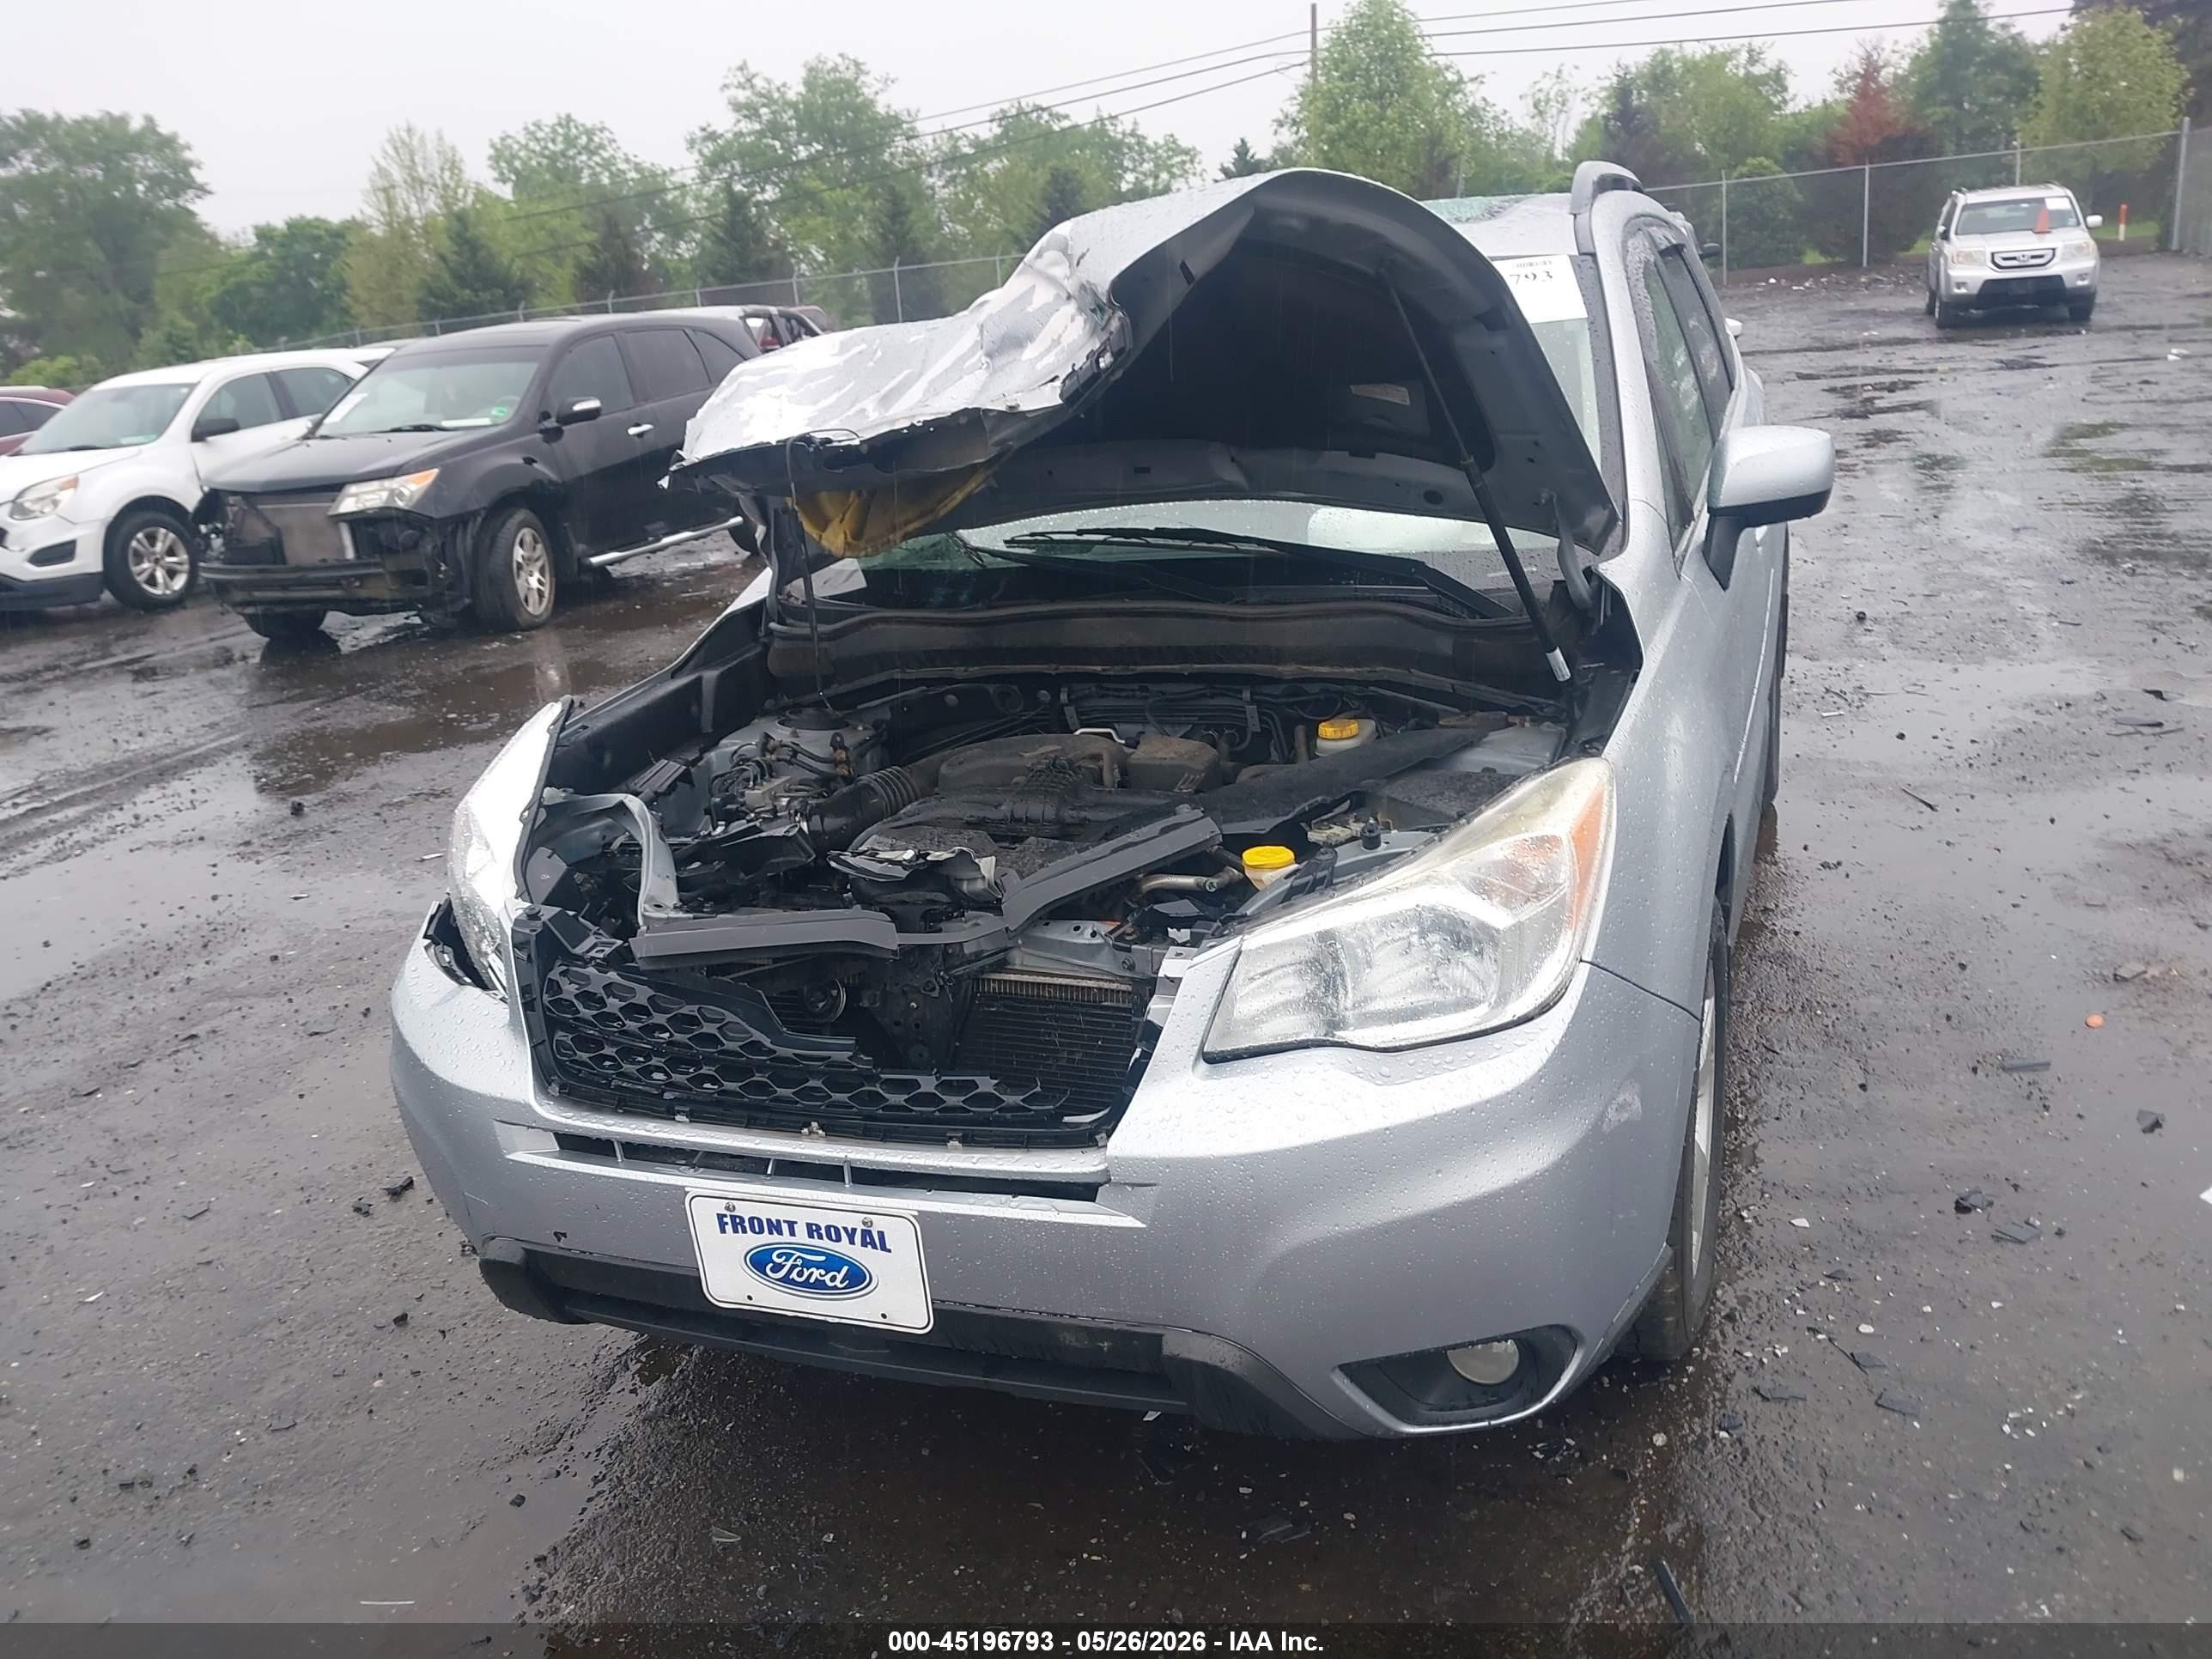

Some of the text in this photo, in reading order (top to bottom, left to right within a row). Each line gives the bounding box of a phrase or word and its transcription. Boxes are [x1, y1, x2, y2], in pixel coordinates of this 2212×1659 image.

[715, 1212, 892, 1254] FRONT ROYAL
[765, 1249, 850, 1289] Ford
